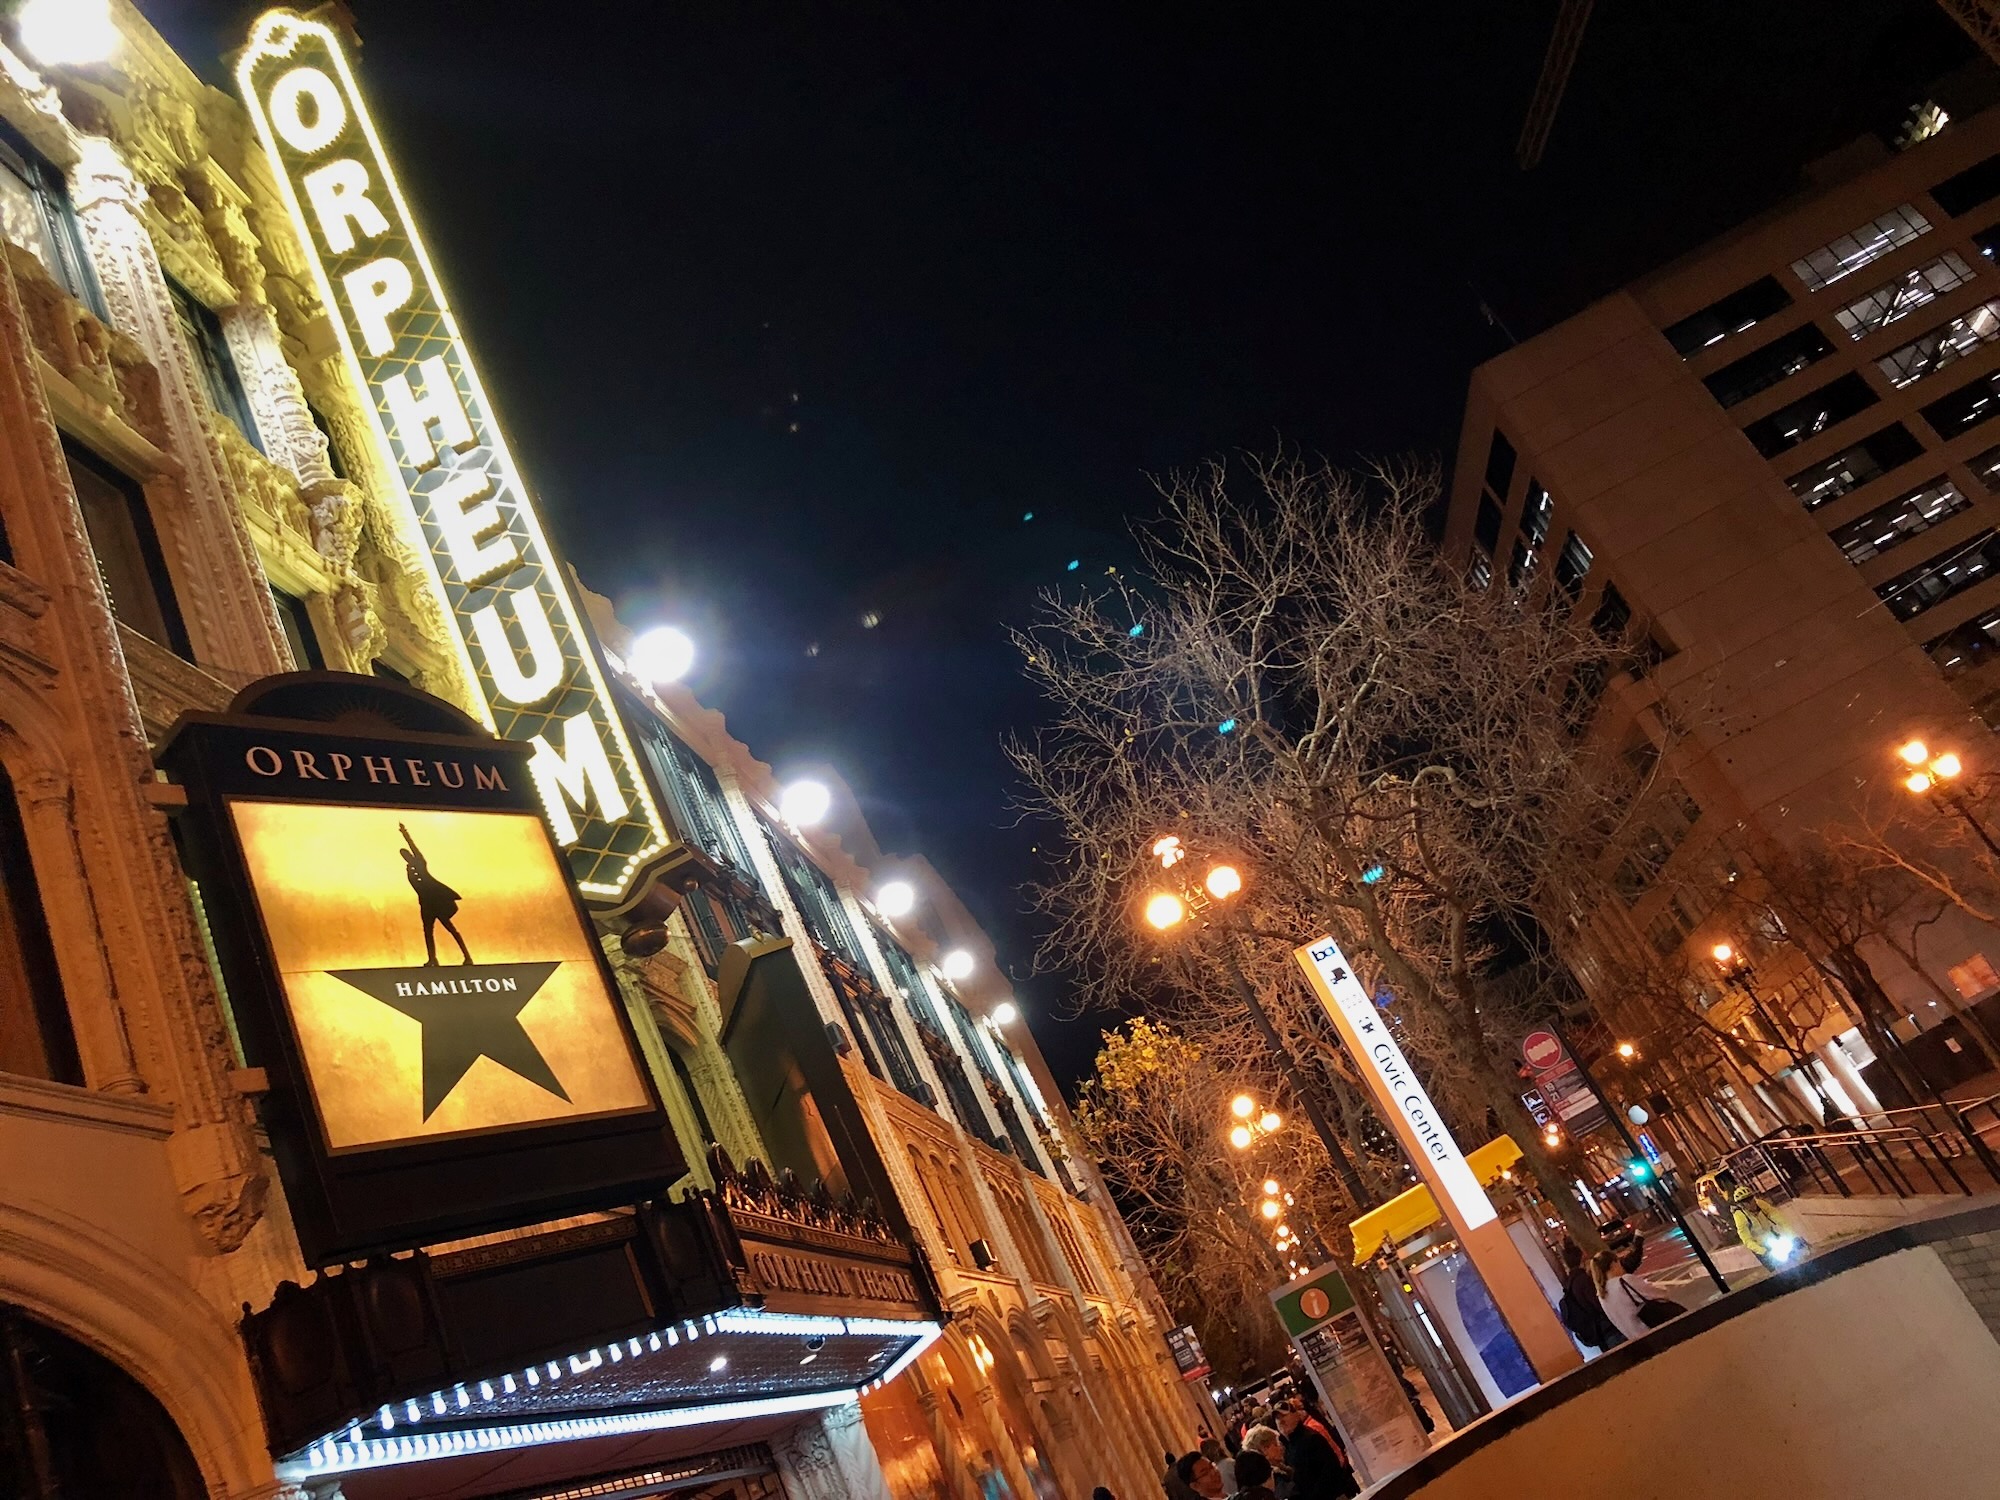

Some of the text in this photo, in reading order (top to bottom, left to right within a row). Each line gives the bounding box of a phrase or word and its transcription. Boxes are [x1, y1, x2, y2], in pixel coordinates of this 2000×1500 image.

[268, 66, 631, 848] ORPHEUM
[244, 746, 510, 792] ORPHEUM
[395, 977, 518, 998] HAMILTON
[1373, 1043, 1450, 1163] Civic Center
[755, 1250, 851, 1296] ORPHEUM
